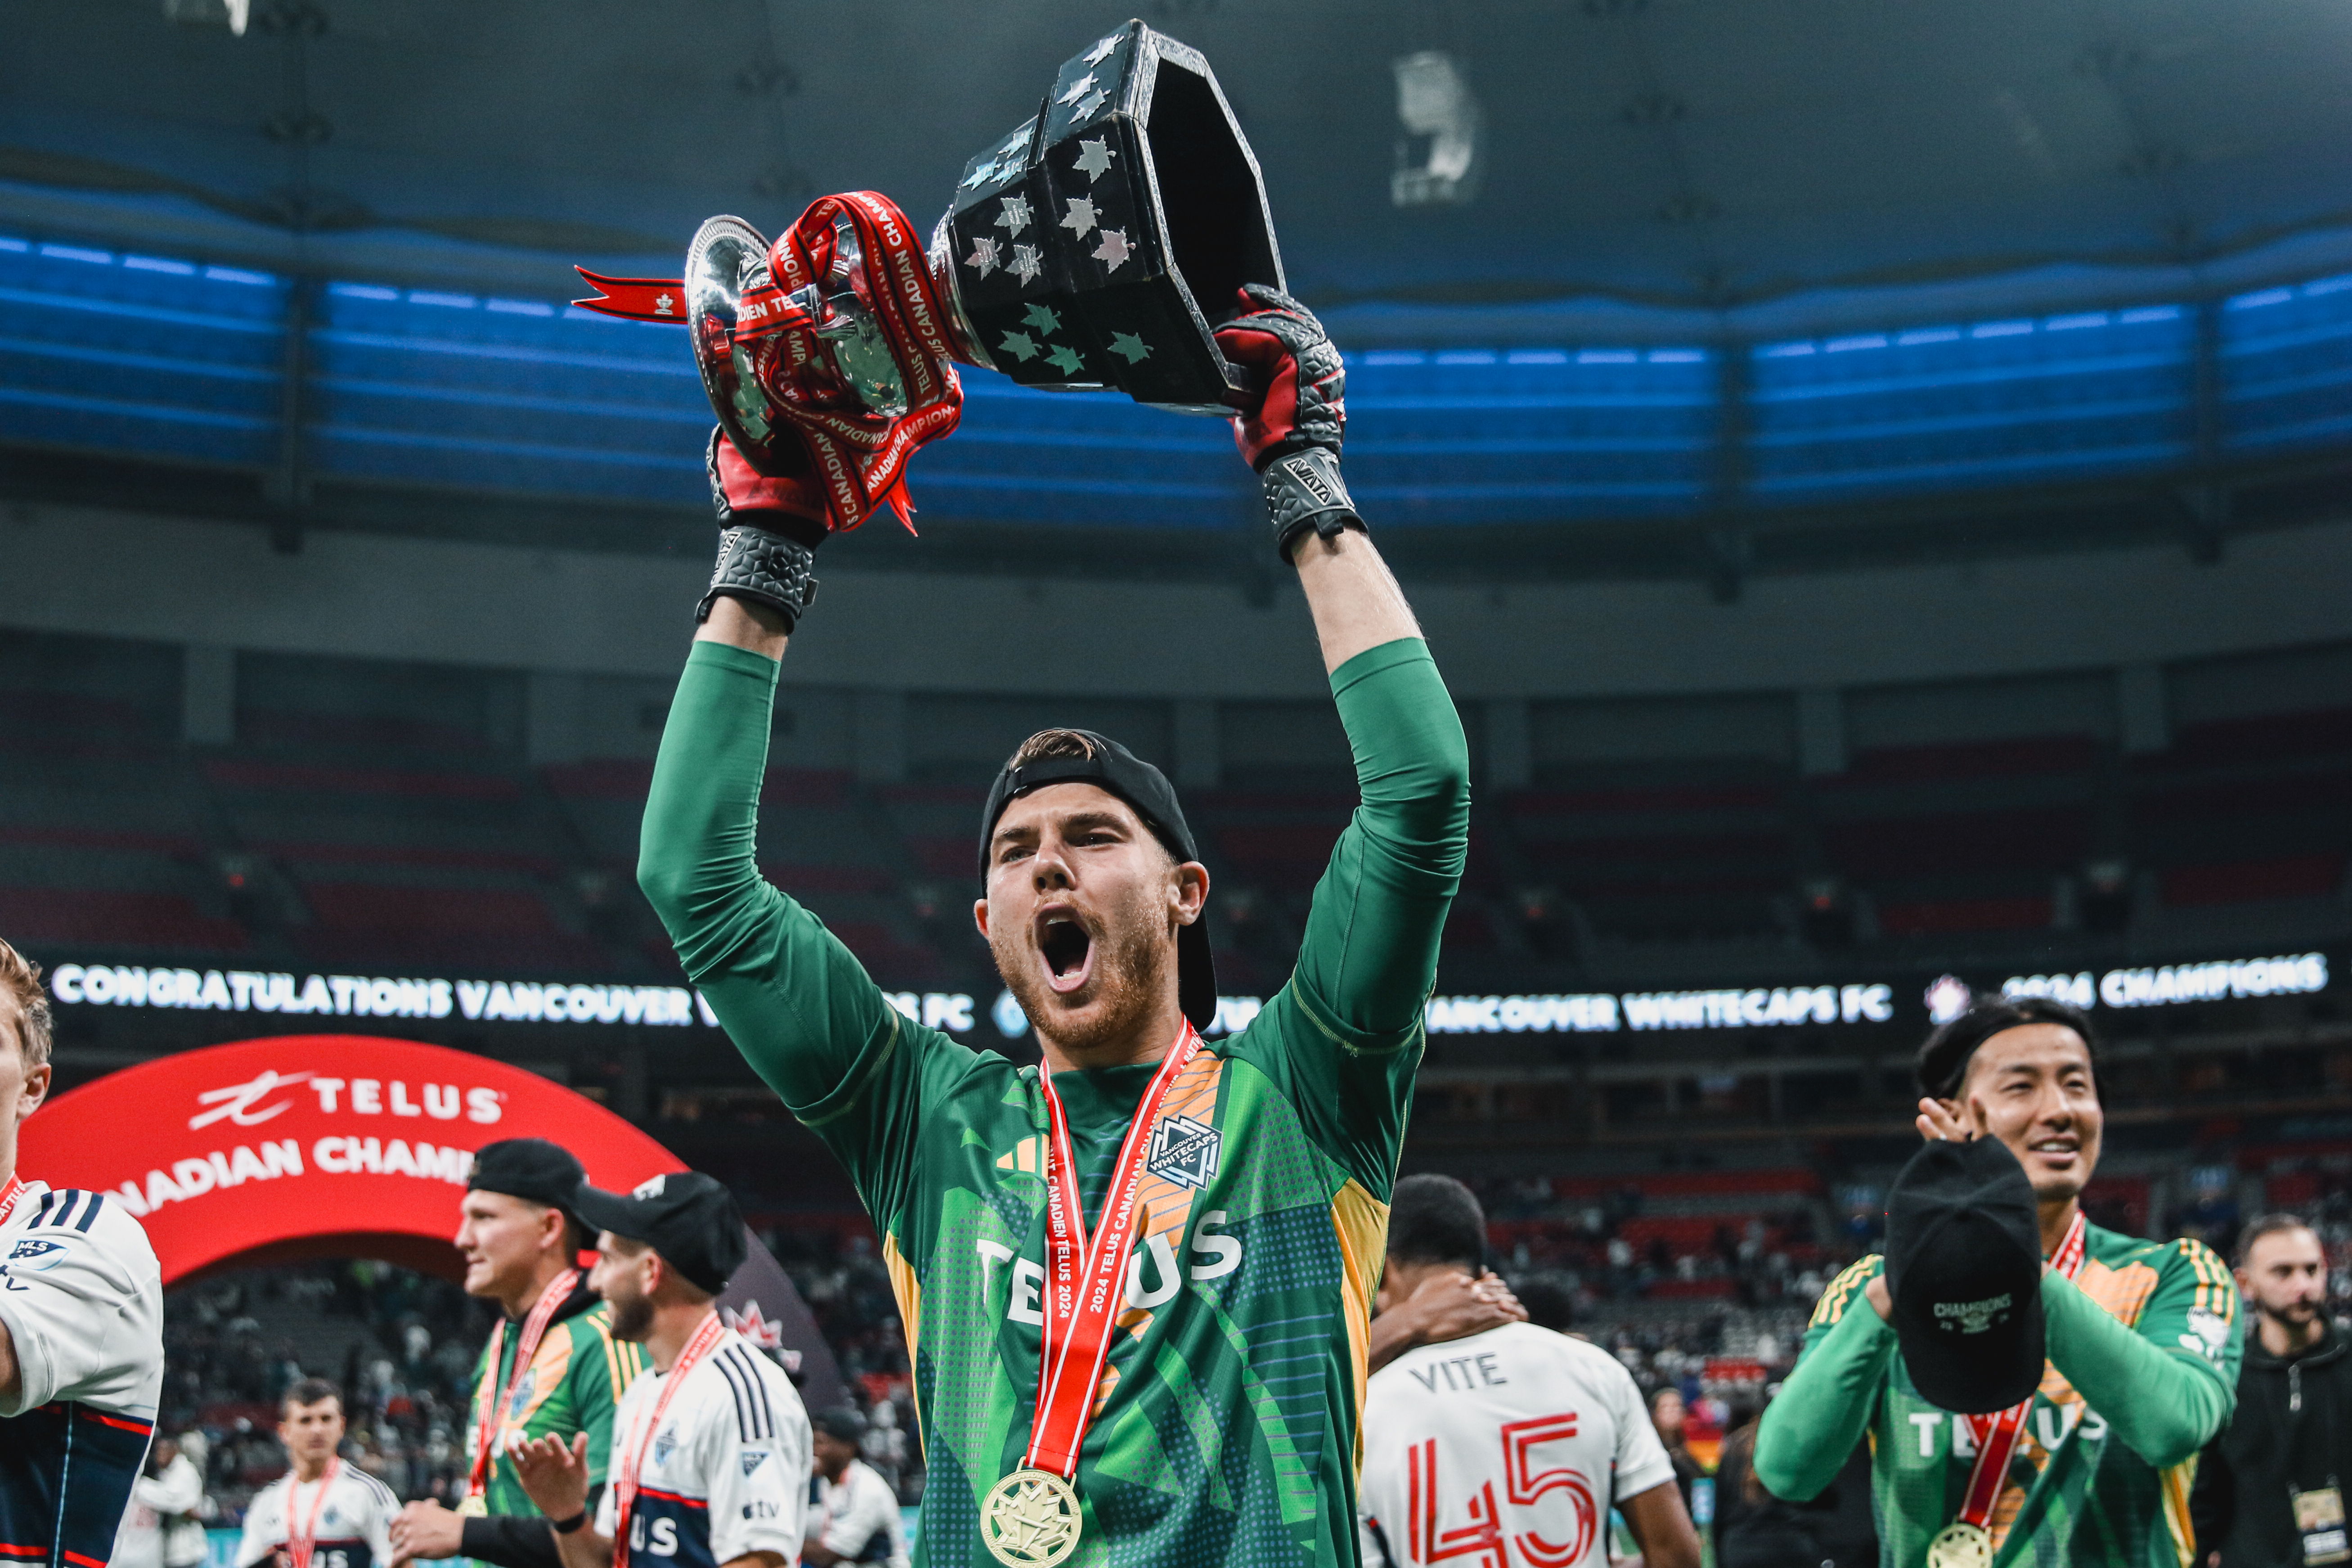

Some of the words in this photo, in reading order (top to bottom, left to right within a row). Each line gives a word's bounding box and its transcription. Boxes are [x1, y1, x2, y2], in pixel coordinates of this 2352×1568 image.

[895, 249, 935, 336] CANADIAN
[814, 432, 857, 515] CANADIAN
[51, 963, 453, 1018] CONGRATULATIONS
[455, 980, 693, 1026] VANCOUVER
[2100, 952, 2329, 1008] CHAMPIONS
[1425, 994, 1620, 1033] ANCOUVER
[1620, 985, 1838, 1030] WHITECAPS
[1840, 984, 1894, 1024] FC
[310, 1077, 502, 1123] TELUS
[1149, 1132, 1218, 1171] WHITECAPS
[1159, 1132, 1202, 1157] VANCOUVER
[1180, 1154, 1197, 1167] FC
[1048, 1176, 1067, 1238] CANADIEN
[18, 1241, 49, 1251] MLS
[1090, 1278, 1109, 1313] 2024
[1100, 1232, 1122, 1274] TELUS
[1114, 1158, 1143, 1231] CANADIAN
[977, 1210, 1243, 1326] TEUS
[1057, 1240, 1072, 1282] TELUS
[1058, 1285, 1072, 1318] 2024
[1408, 1351, 1508, 1394] VITE
[1049, 1477, 1079, 1515] CHAMPIONSHIP
[1408, 1412, 1597, 1568] 45
